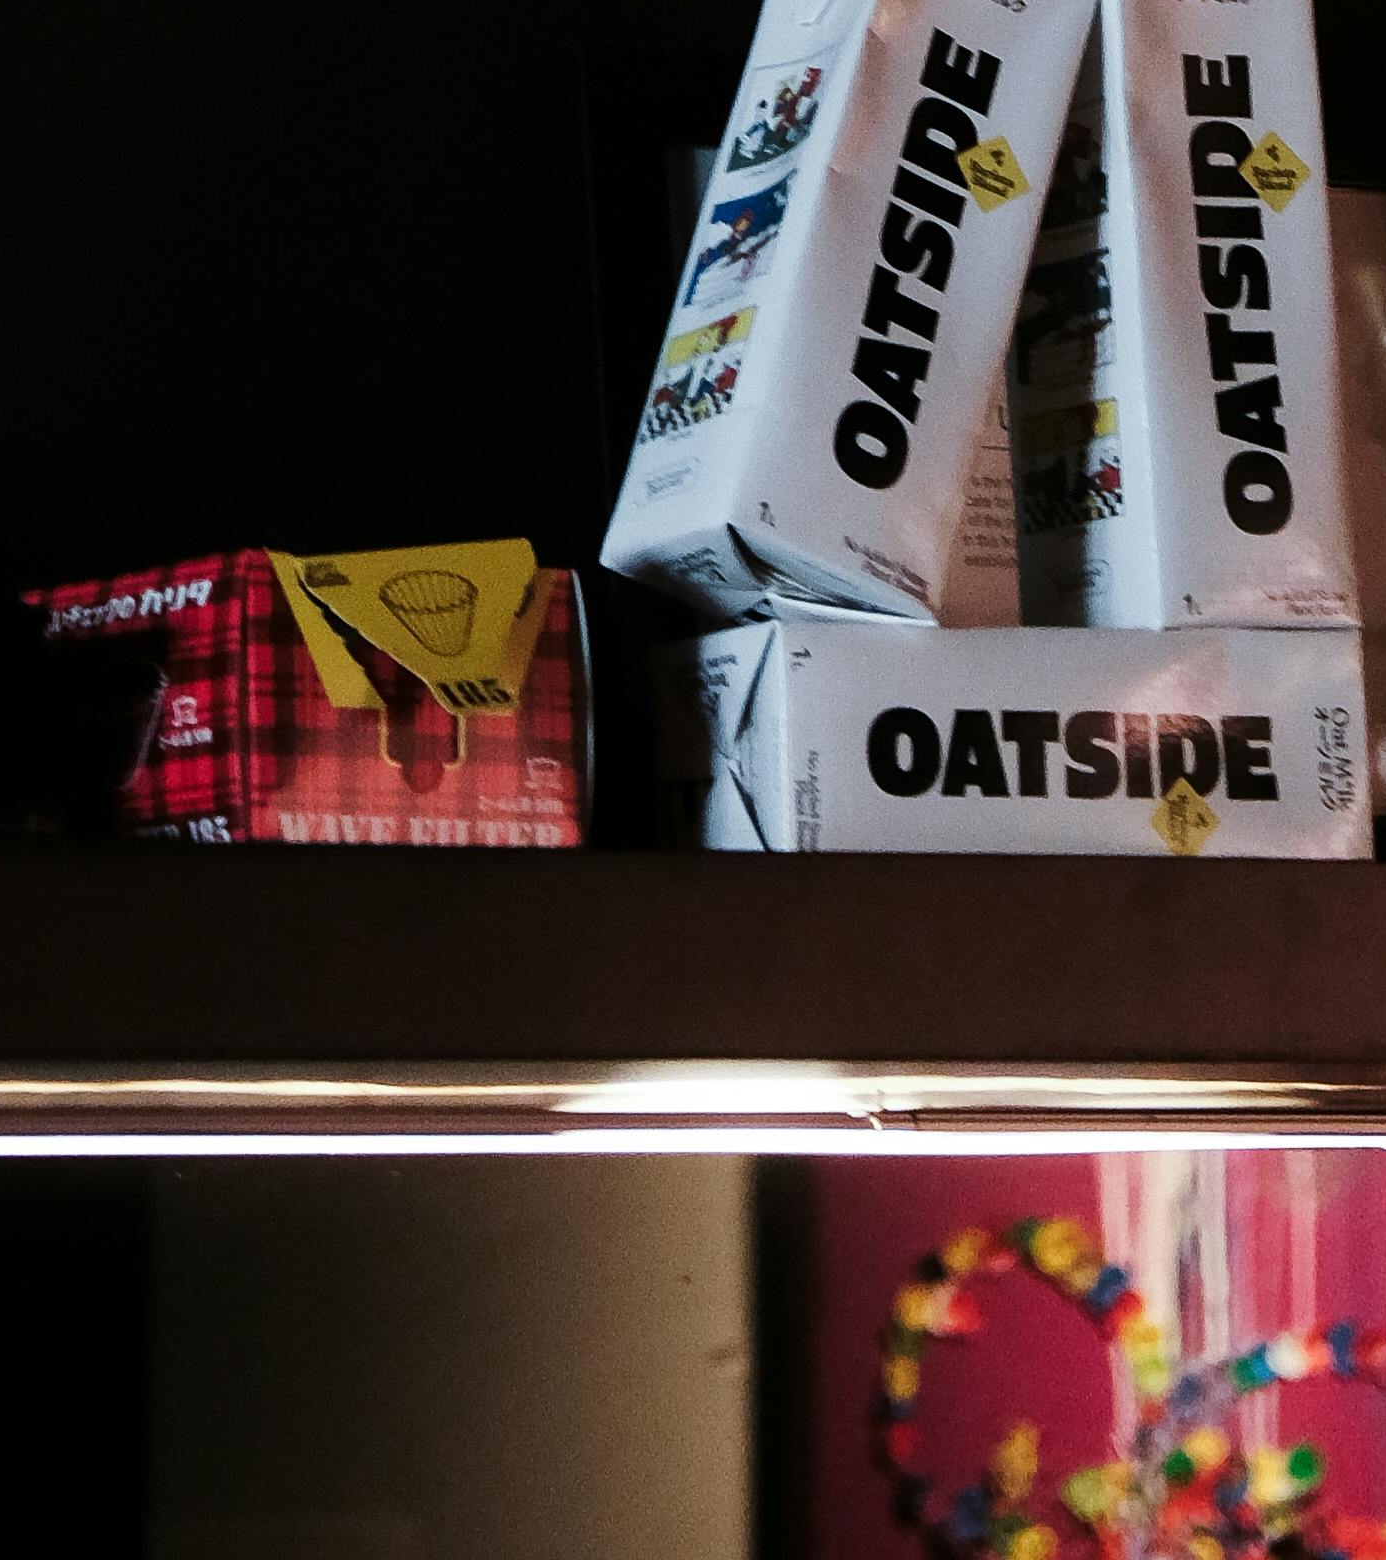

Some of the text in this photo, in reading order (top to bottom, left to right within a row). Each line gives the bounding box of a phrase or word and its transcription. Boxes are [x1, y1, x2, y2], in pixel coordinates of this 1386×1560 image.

[832, 25, 1003, 491] OATSIDE
[1181, 53, 1295, 536] OATSIDE
[866, 705, 1280, 801] OATSIDE
